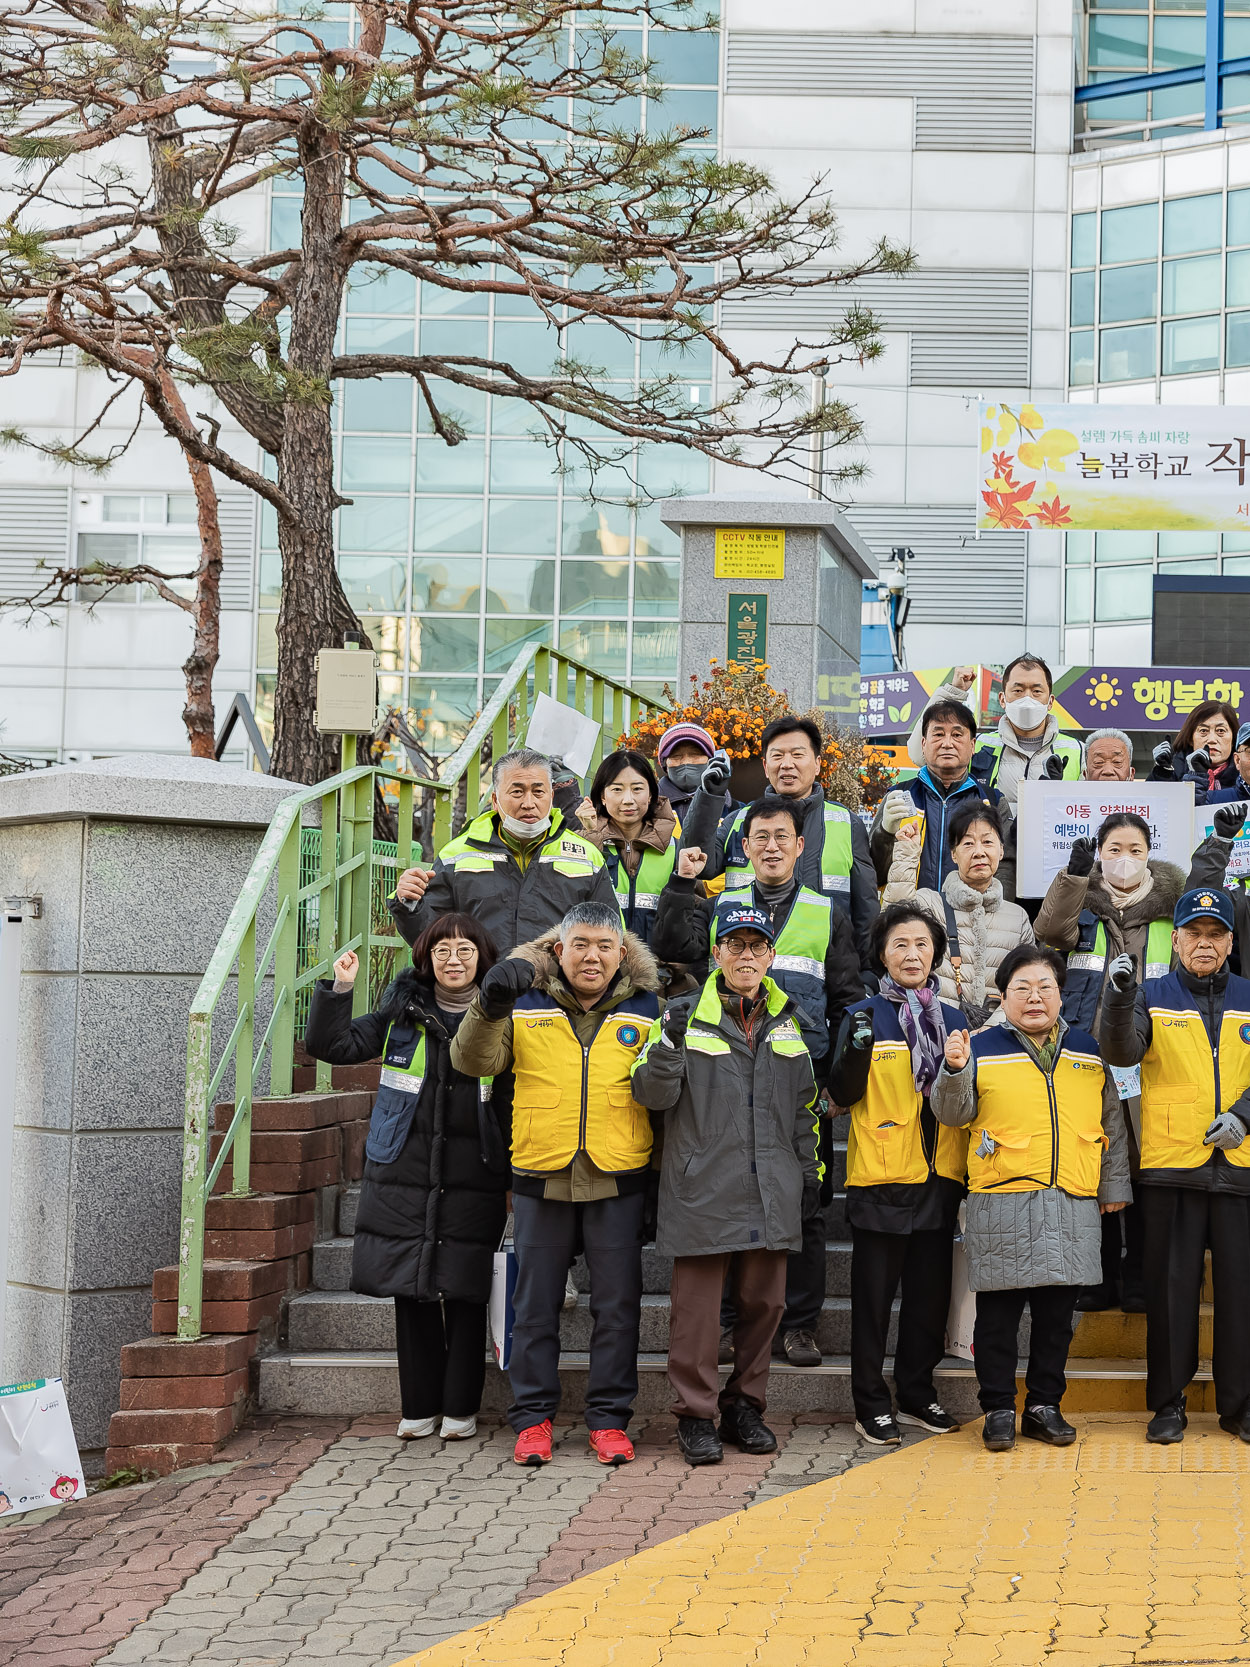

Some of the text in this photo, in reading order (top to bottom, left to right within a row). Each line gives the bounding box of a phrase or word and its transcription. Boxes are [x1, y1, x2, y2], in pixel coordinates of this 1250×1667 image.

[1081, 430, 1106, 444] 설렘
[1110, 430, 1133, 443] 가득
[1165, 431, 1190, 444] 자랑
[1076, 451, 1192, 480] 늘봄학교
[722, 533, 745, 541] CCTV
[1066, 804, 1091, 819] 아동
[1054, 824, 1090, 837] 예방이
[726, 909, 767, 925] CANADA
